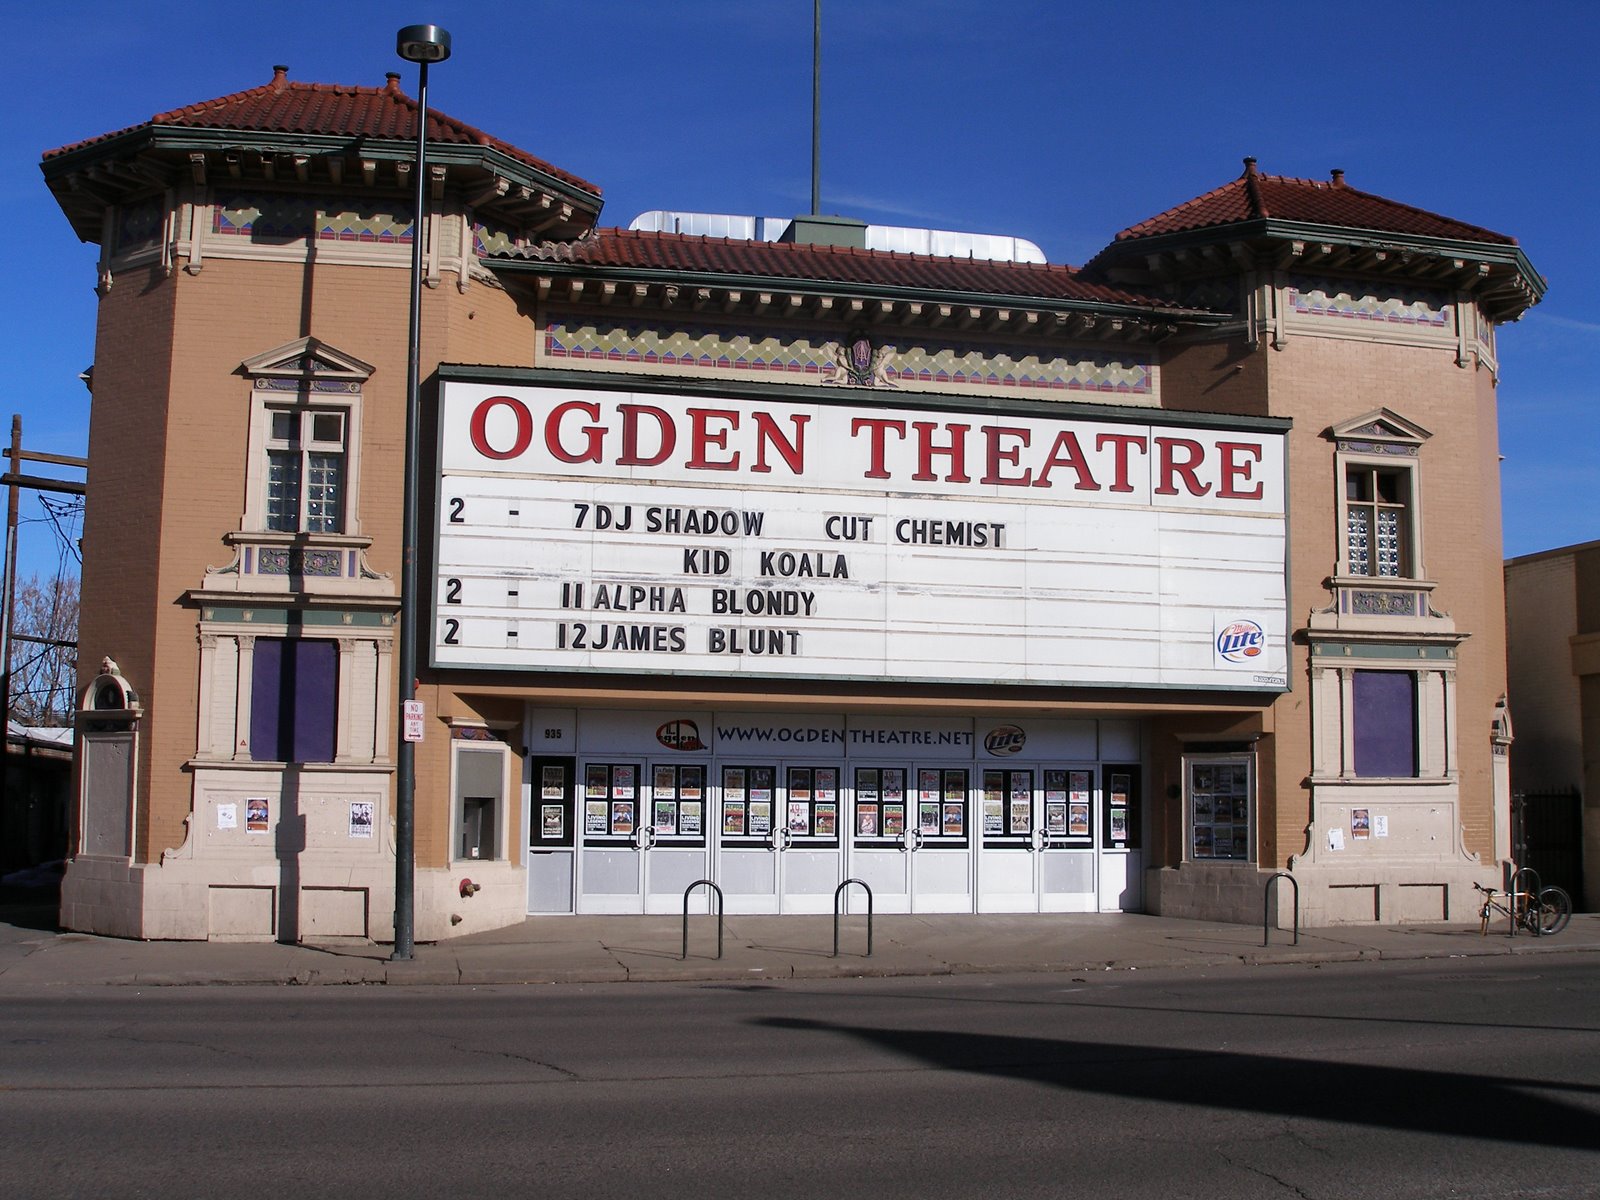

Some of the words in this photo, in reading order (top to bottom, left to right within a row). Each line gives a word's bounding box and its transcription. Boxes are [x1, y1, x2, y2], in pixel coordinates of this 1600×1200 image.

[470, 396, 811, 475] OGDEN
[851, 417, 1264, 500] THEATRE
[450, 497, 465, 523] 2
[646, 507, 764, 537] SHADOW
[825, 515, 873, 541] CUT
[895, 518, 1005, 548] CHEMIST
[683, 548, 730, 575] KID
[760, 551, 849, 579] KOALA
[446, 578, 462, 604] 2
[593, 584, 686, 613] ALPHA
[712, 588, 815, 616] BLONDY
[444, 618, 460, 645] 2
[709, 628, 801, 655] BLUNT
[1221, 631, 1263, 653] Lite
[405, 712, 424, 721] PARKING
[410, 703, 419, 713] NO
[544, 728, 562, 739] 935
